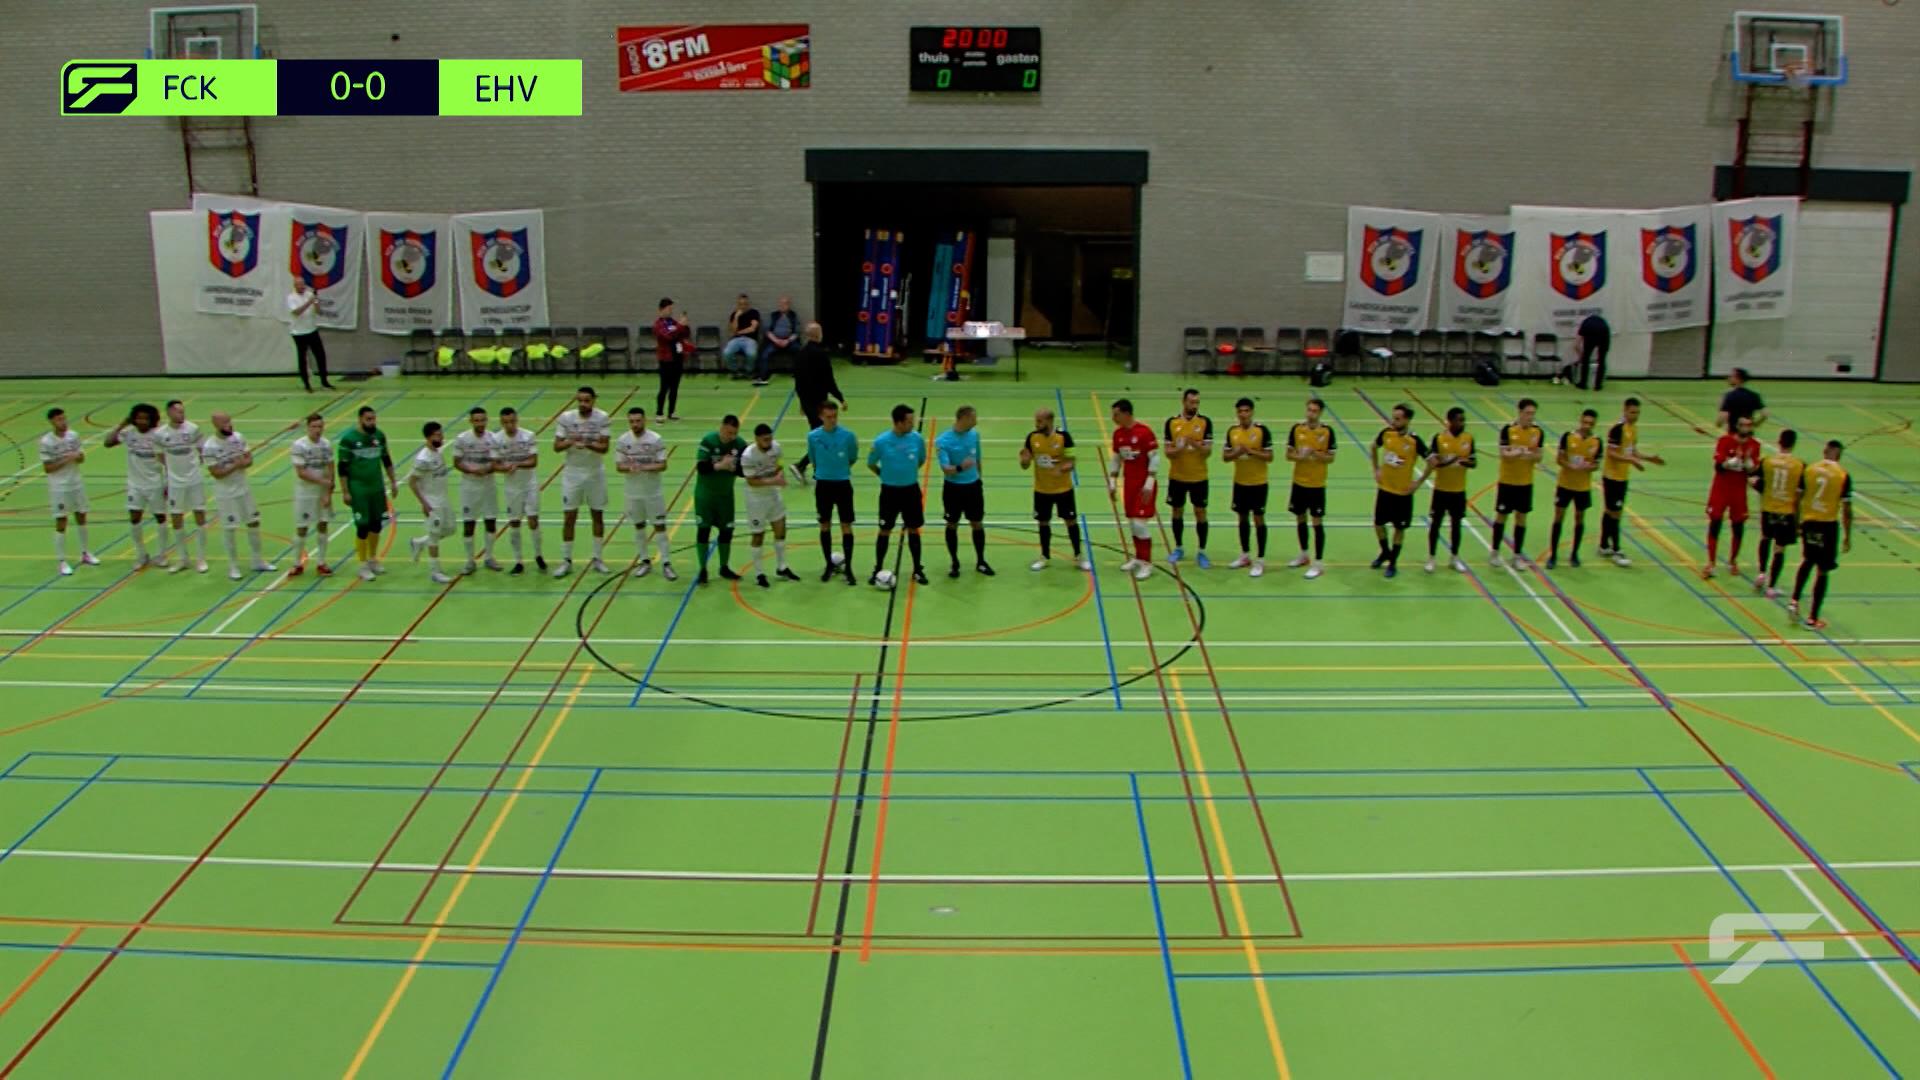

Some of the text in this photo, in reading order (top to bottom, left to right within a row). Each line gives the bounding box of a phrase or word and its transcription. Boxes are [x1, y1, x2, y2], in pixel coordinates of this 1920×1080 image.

[918, 51, 950, 64] thuis
[996, 53, 1039, 66] gasten
[937, 69, 952, 88] 0
[1023, 69, 1038, 88] 0
[1811, 477, 1829, 513] 2
